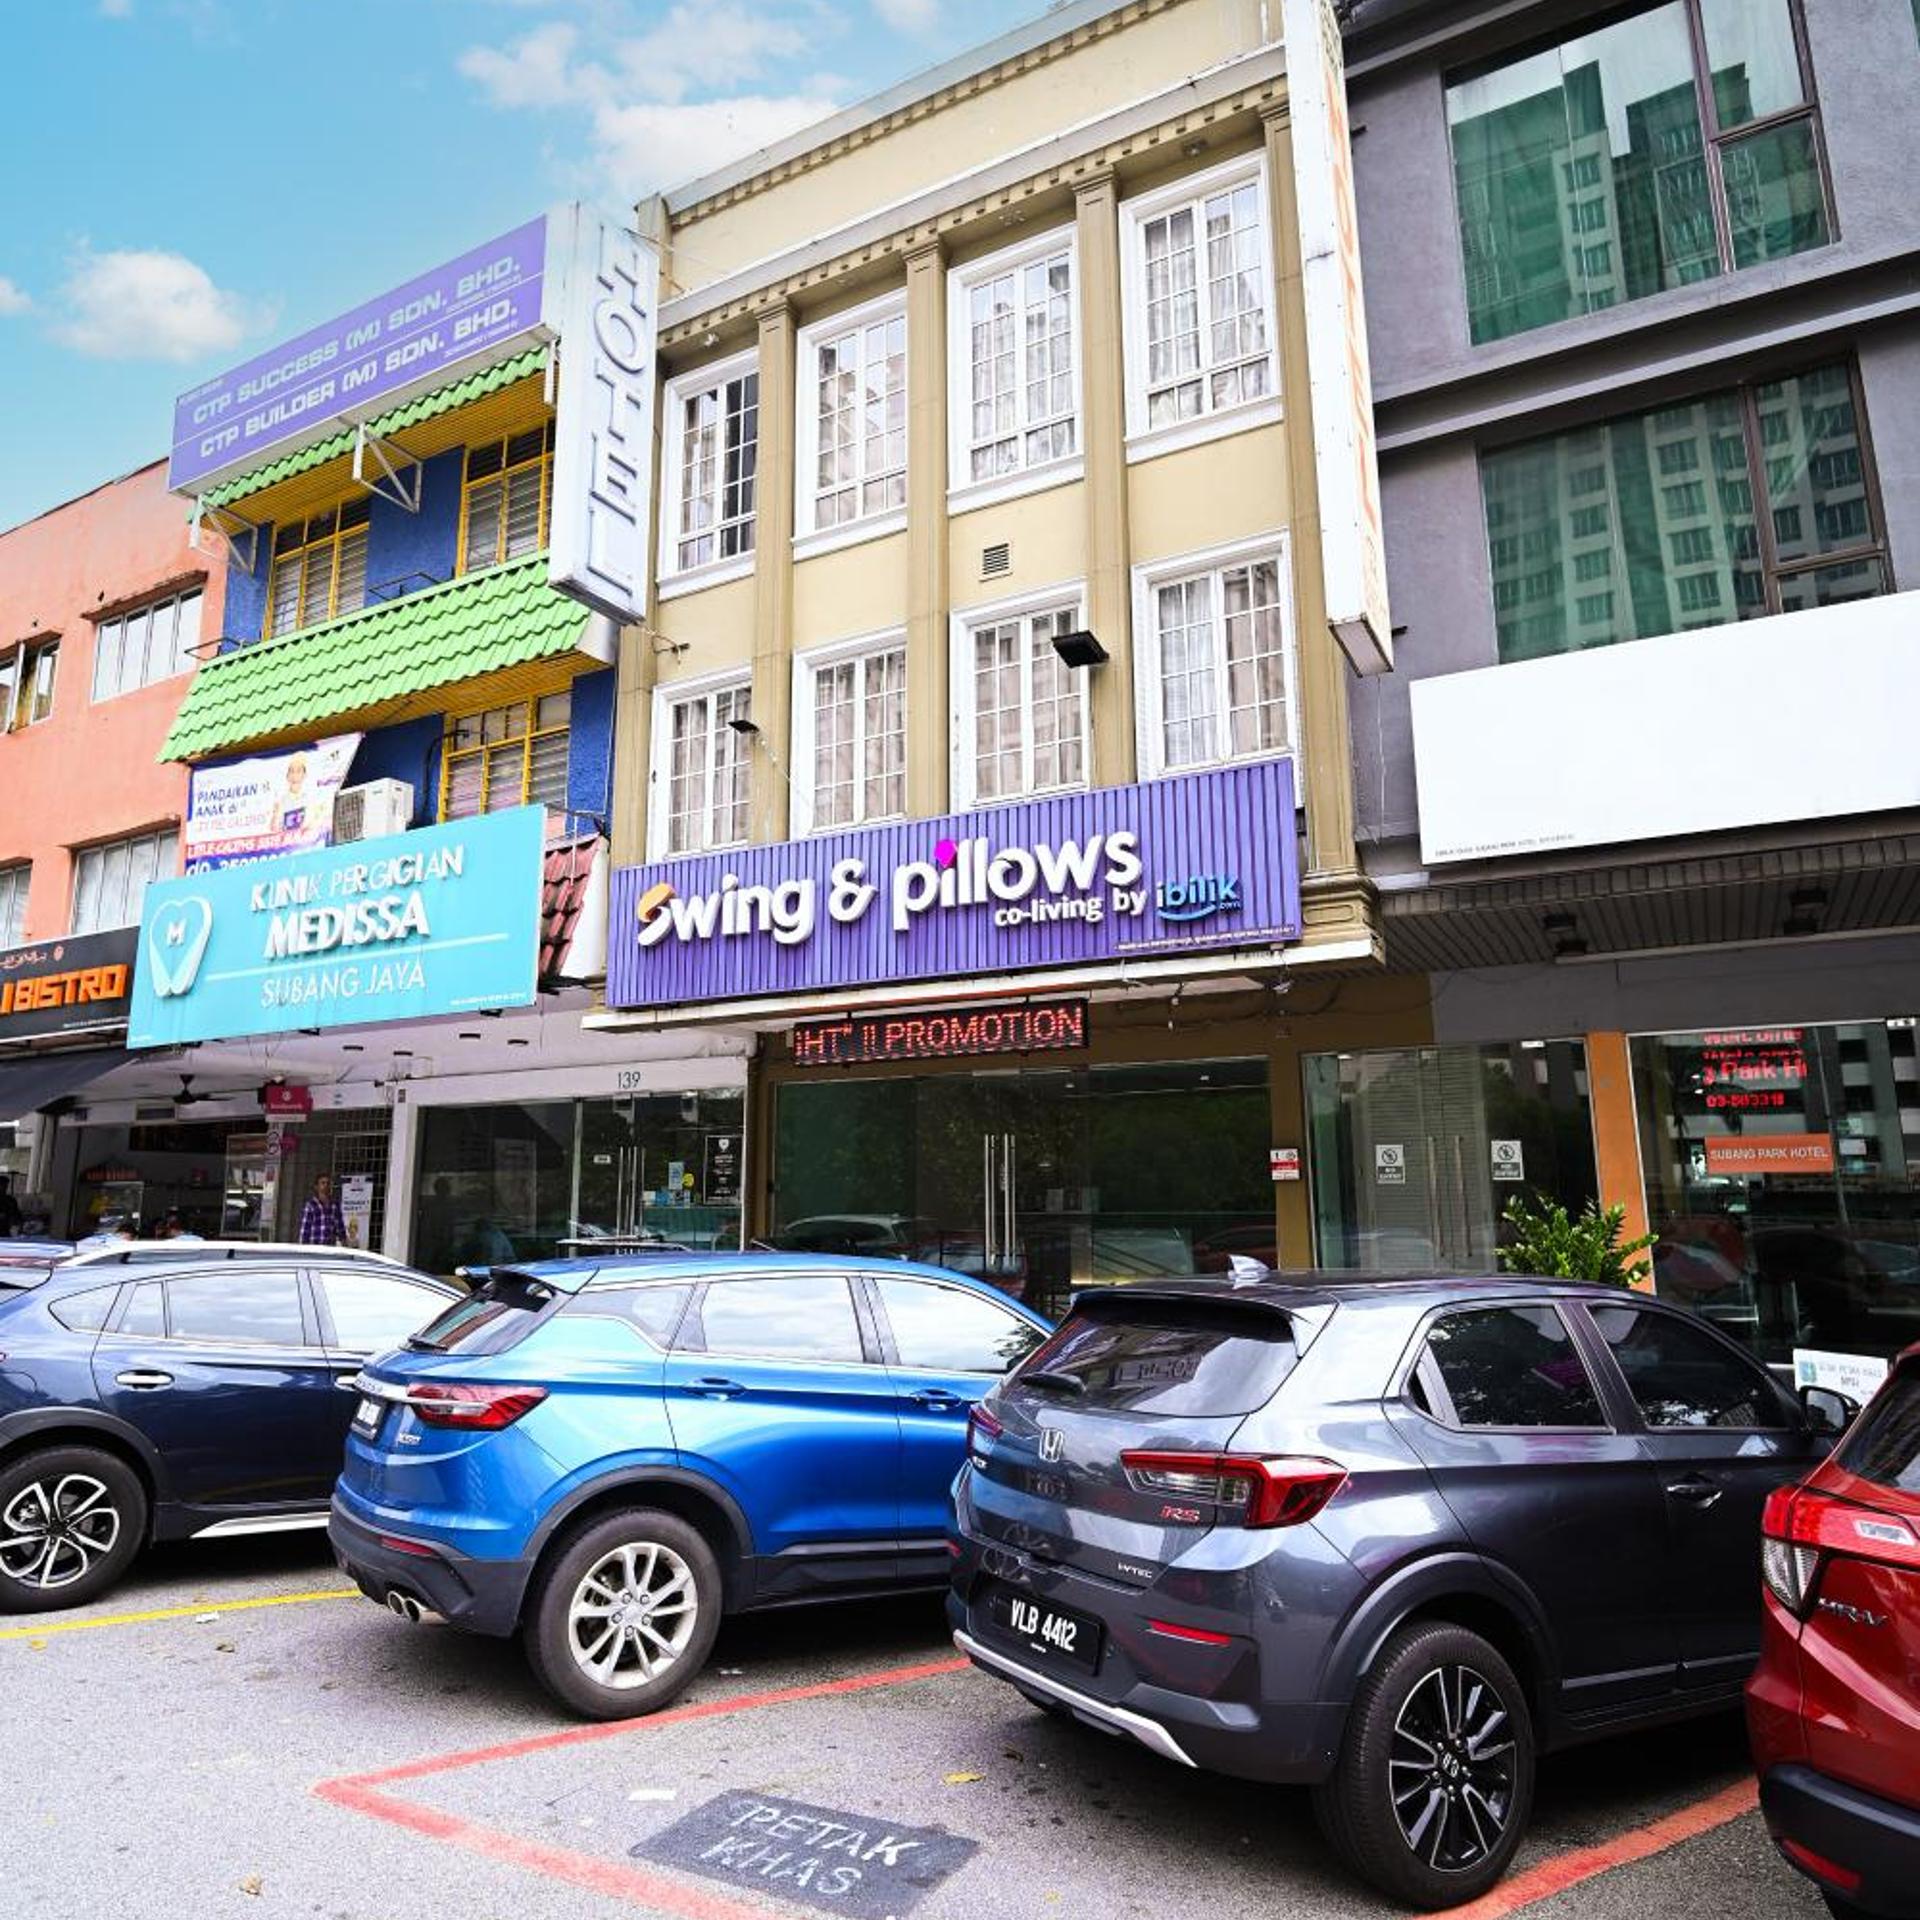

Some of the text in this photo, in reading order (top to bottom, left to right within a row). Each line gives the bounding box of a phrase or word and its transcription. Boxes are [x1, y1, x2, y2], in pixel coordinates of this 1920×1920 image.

[193, 392, 231, 424] CTP
[237, 340, 339, 403] SUCCESS
[345, 318, 381, 351] (M)
[388, 288, 448, 331] SDN.
[456, 256, 520, 299] BHD.
[200, 425, 239, 458] CTP
[245, 380, 335, 436] BUILDER
[341, 360, 378, 393] (M)
[384, 331, 445, 372] SDN.
[454, 299, 518, 342] BHD.
[586, 223, 649, 597] HOTEL
[330, 844, 464, 899] PERGIGIAN
[828, 857, 877, 923] &
[893, 831, 1143, 931] pillows
[263, 890, 430, 959] MEDISSA
[995, 873, 1239, 927] co-living by ibilik
[13, 963, 128, 1012] BISTRO
[261, 955, 426, 1008] SUBANG JAYA
[886, 1007, 1083, 1050] PROMOTION
[617, 1070, 641, 1089] 139
[1710, 1146, 1828, 1161] SUBANG PARK HOTEL
[1160, 1505, 1201, 1523] RS
[1011, 1598, 1077, 1652] VLB 4412
[730, 1804, 924, 1867] PETAK
[700, 1835, 862, 1895] KHAS
